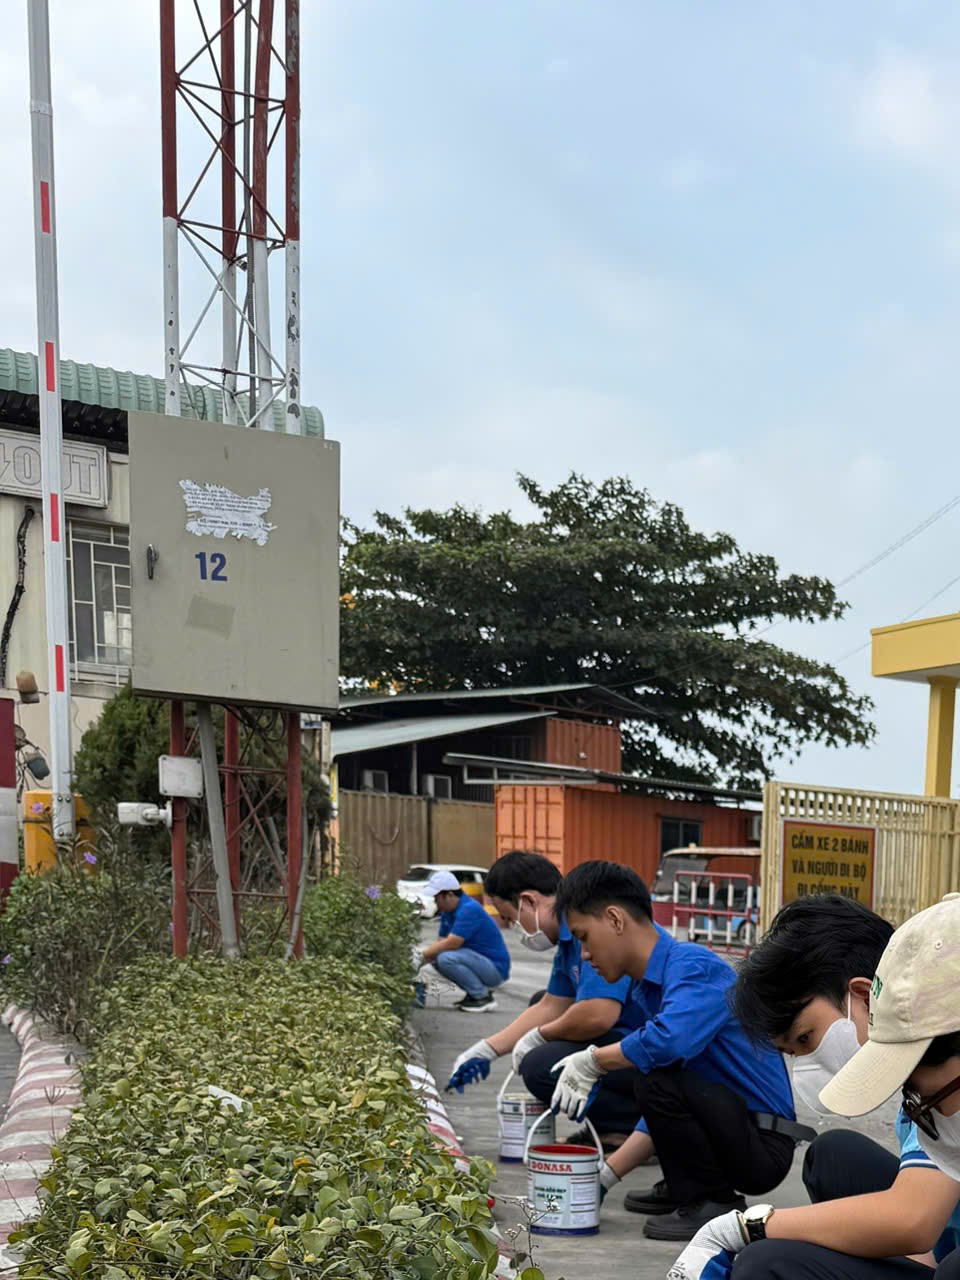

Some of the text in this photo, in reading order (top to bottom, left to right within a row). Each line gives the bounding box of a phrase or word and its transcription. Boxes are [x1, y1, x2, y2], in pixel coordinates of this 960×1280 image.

[13, 445, 97, 495] OT
[194, 551, 228, 582] 12
[817, 836, 830, 851] XE
[832, 838, 839, 852] 2
[841, 835, 869, 854] BÁNH
[792, 857, 805, 874] VÀ
[840, 862, 850, 877] ĐI
[531, 1161, 573, 1173] DONASA
